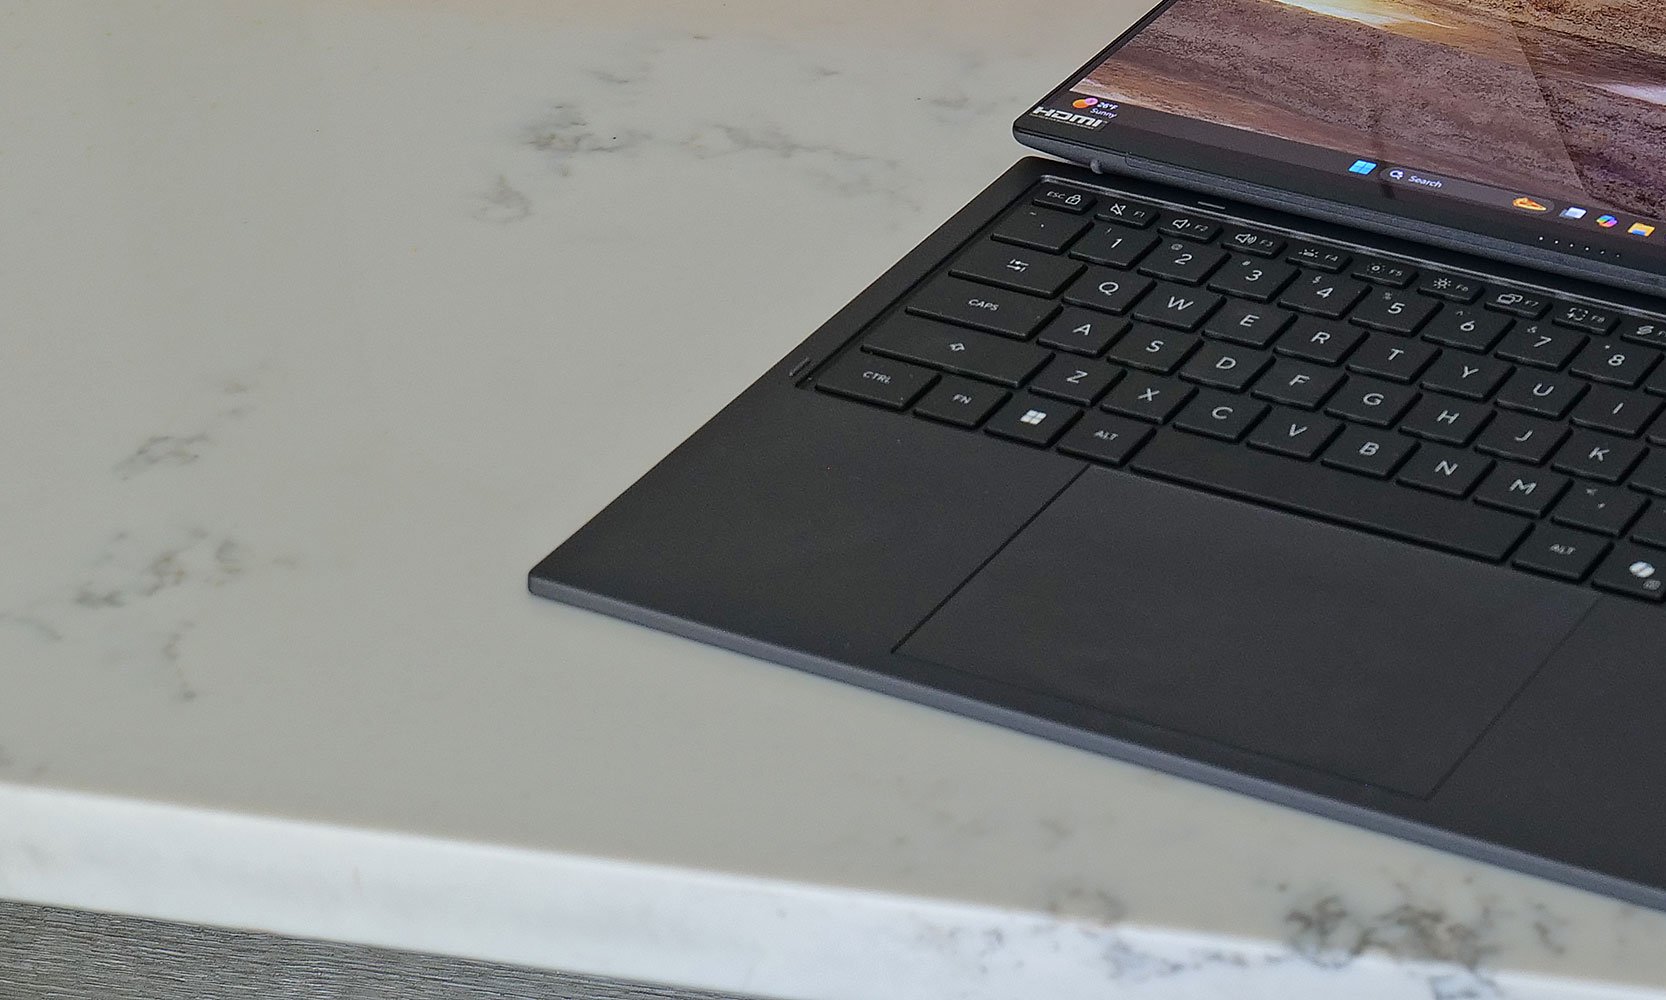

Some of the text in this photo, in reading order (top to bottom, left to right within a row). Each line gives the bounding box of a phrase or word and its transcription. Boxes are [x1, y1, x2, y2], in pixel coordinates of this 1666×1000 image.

[1032, 105, 1104, 128] HDMI
[1089, 107, 1118, 119] Sunny
[1408, 175, 1442, 188] Search
[1046, 190, 1066, 200] ESC
[1193, 223, 1209, 232] F2
[1110, 238, 1123, 250] 1
[1258, 238, 1274, 248] F3
[1174, 253, 1193, 265] 2
[1324, 253, 1339, 263] F4
[1245, 269, 1263, 281] 3
[1388, 268, 1403, 277] F5
[1098, 281, 1119, 296] Q
[1316, 287, 1334, 299] 4
[968, 298, 1000, 311] CAPS
[1167, 296, 1194, 311] W
[1387, 302, 1406, 314] 5
[1239, 314, 1260, 327] E
[1460, 320, 1475, 332] 6
[1072, 323, 1091, 336] A
[1310, 331, 1331, 345] R
[1533, 335, 1552, 348] 7
[1145, 340, 1164, 353] S
[1387, 348, 1405, 361] T
[1607, 354, 1626, 367] 8
[1215, 356, 1237, 370] D
[862, 371, 891, 384] CTRL
[1066, 370, 1088, 384] Z
[1461, 365, 1479, 379] Y
[1288, 374, 1311, 386] F
[1138, 387, 1160, 402] X
[1532, 383, 1555, 397] U
[952, 393, 972, 404] FN
[1362, 392, 1385, 406] G
[1211, 406, 1234, 420] C
[1611, 401, 1625, 416] I
[1436, 410, 1460, 425] H
[1094, 430, 1119, 441] ALT
[1288, 423, 1308, 437] V
[1514, 430, 1533, 442] J
[1358, 441, 1380, 456] B
[1588, 447, 1610, 462] K
[1434, 460, 1458, 476] N
[1509, 478, 1537, 495] M
[1549, 543, 1576, 555] ALT
